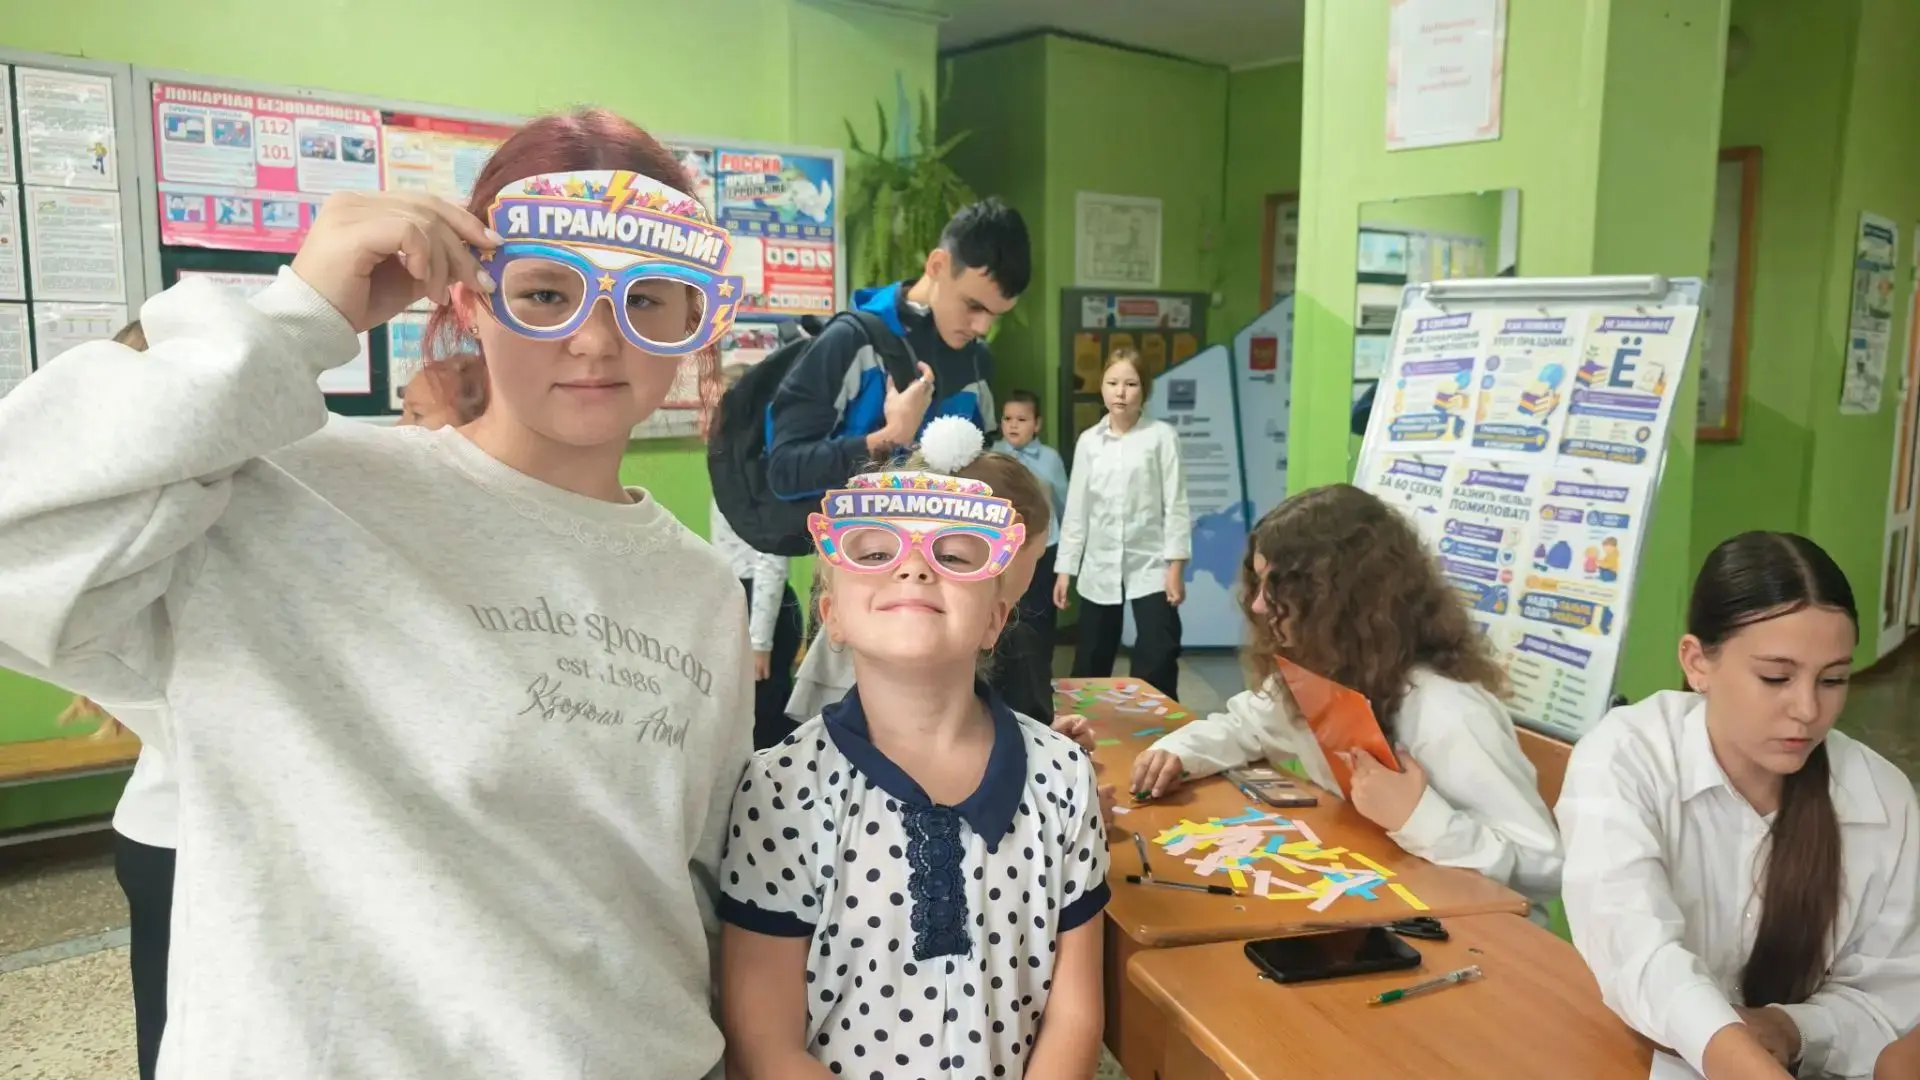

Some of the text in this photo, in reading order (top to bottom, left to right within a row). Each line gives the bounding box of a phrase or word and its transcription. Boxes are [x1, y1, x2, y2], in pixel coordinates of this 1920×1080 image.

[164, 86, 372, 123] ПОЖАРНАЯ БЕЗОПАСНОСТЬ
[260, 119, 289, 136] 112
[261, 144, 292, 160] 101
[721, 153, 782, 174] РОССИЯ
[508, 205, 530, 234] Я
[538, 206, 724, 265] ГРАМОТНЫЙ!
[1608, 336, 1643, 388] Ё
[1378, 474, 1392, 486] ЗА
[1394, 478, 1409, 491] 60
[834, 494, 1009, 524] Я ГРАМОТНАЯ!
[467, 596, 713, 697] made sponcon
